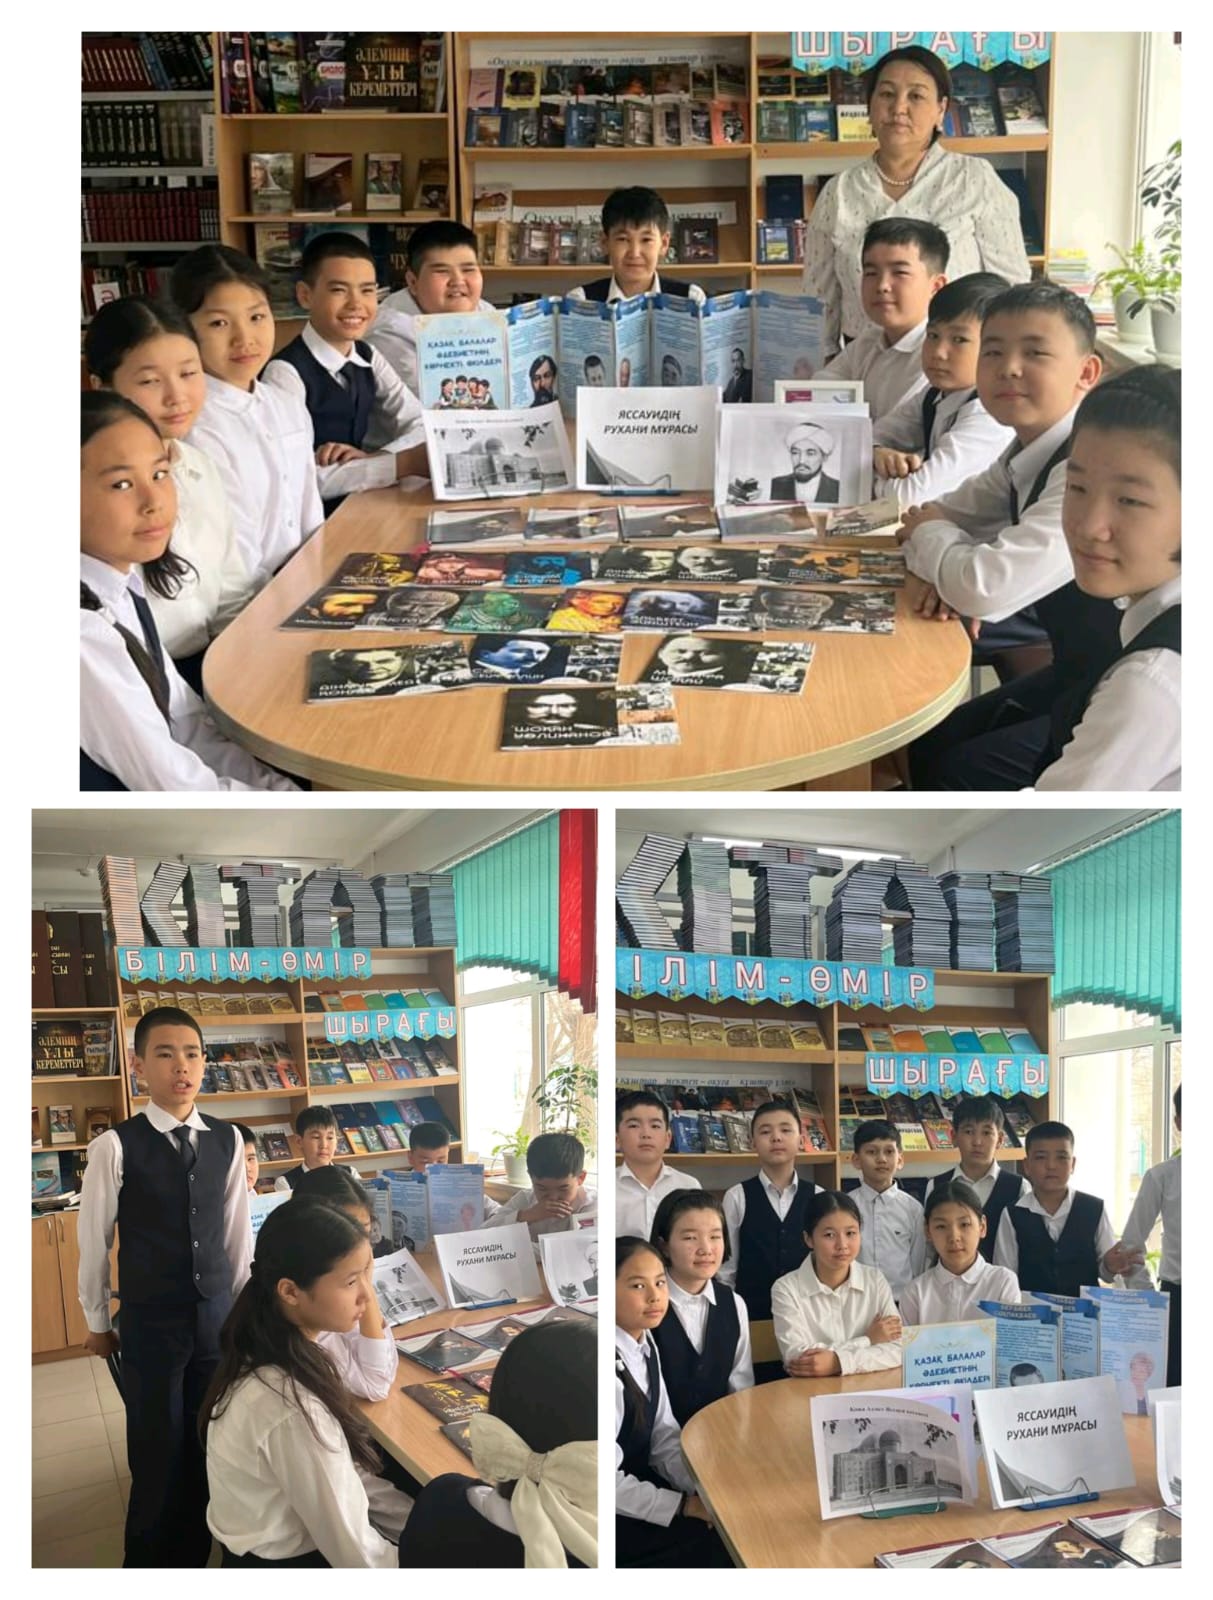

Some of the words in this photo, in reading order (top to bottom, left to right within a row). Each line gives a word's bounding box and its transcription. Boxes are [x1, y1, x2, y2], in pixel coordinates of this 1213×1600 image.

[603, 425, 648, 434] РУХАНИ
[632, 953, 929, 1000] ІЛІМ-ӨМІР
[326, 1010, 455, 1036] ШЫРАҒЫ
[867, 1055, 1047, 1086] ШЫРАҒЫ
[456, 1256, 485, 1266] РУХАНИ
[947, 1350, 986, 1362] БАЛАЛАР
[1016, 1405, 1078, 1423] ЯССАУИДІҢ
[1006, 1425, 1049, 1441] РУХАНИ
[1051, 1418, 1098, 1436] МҰРАСЫ
